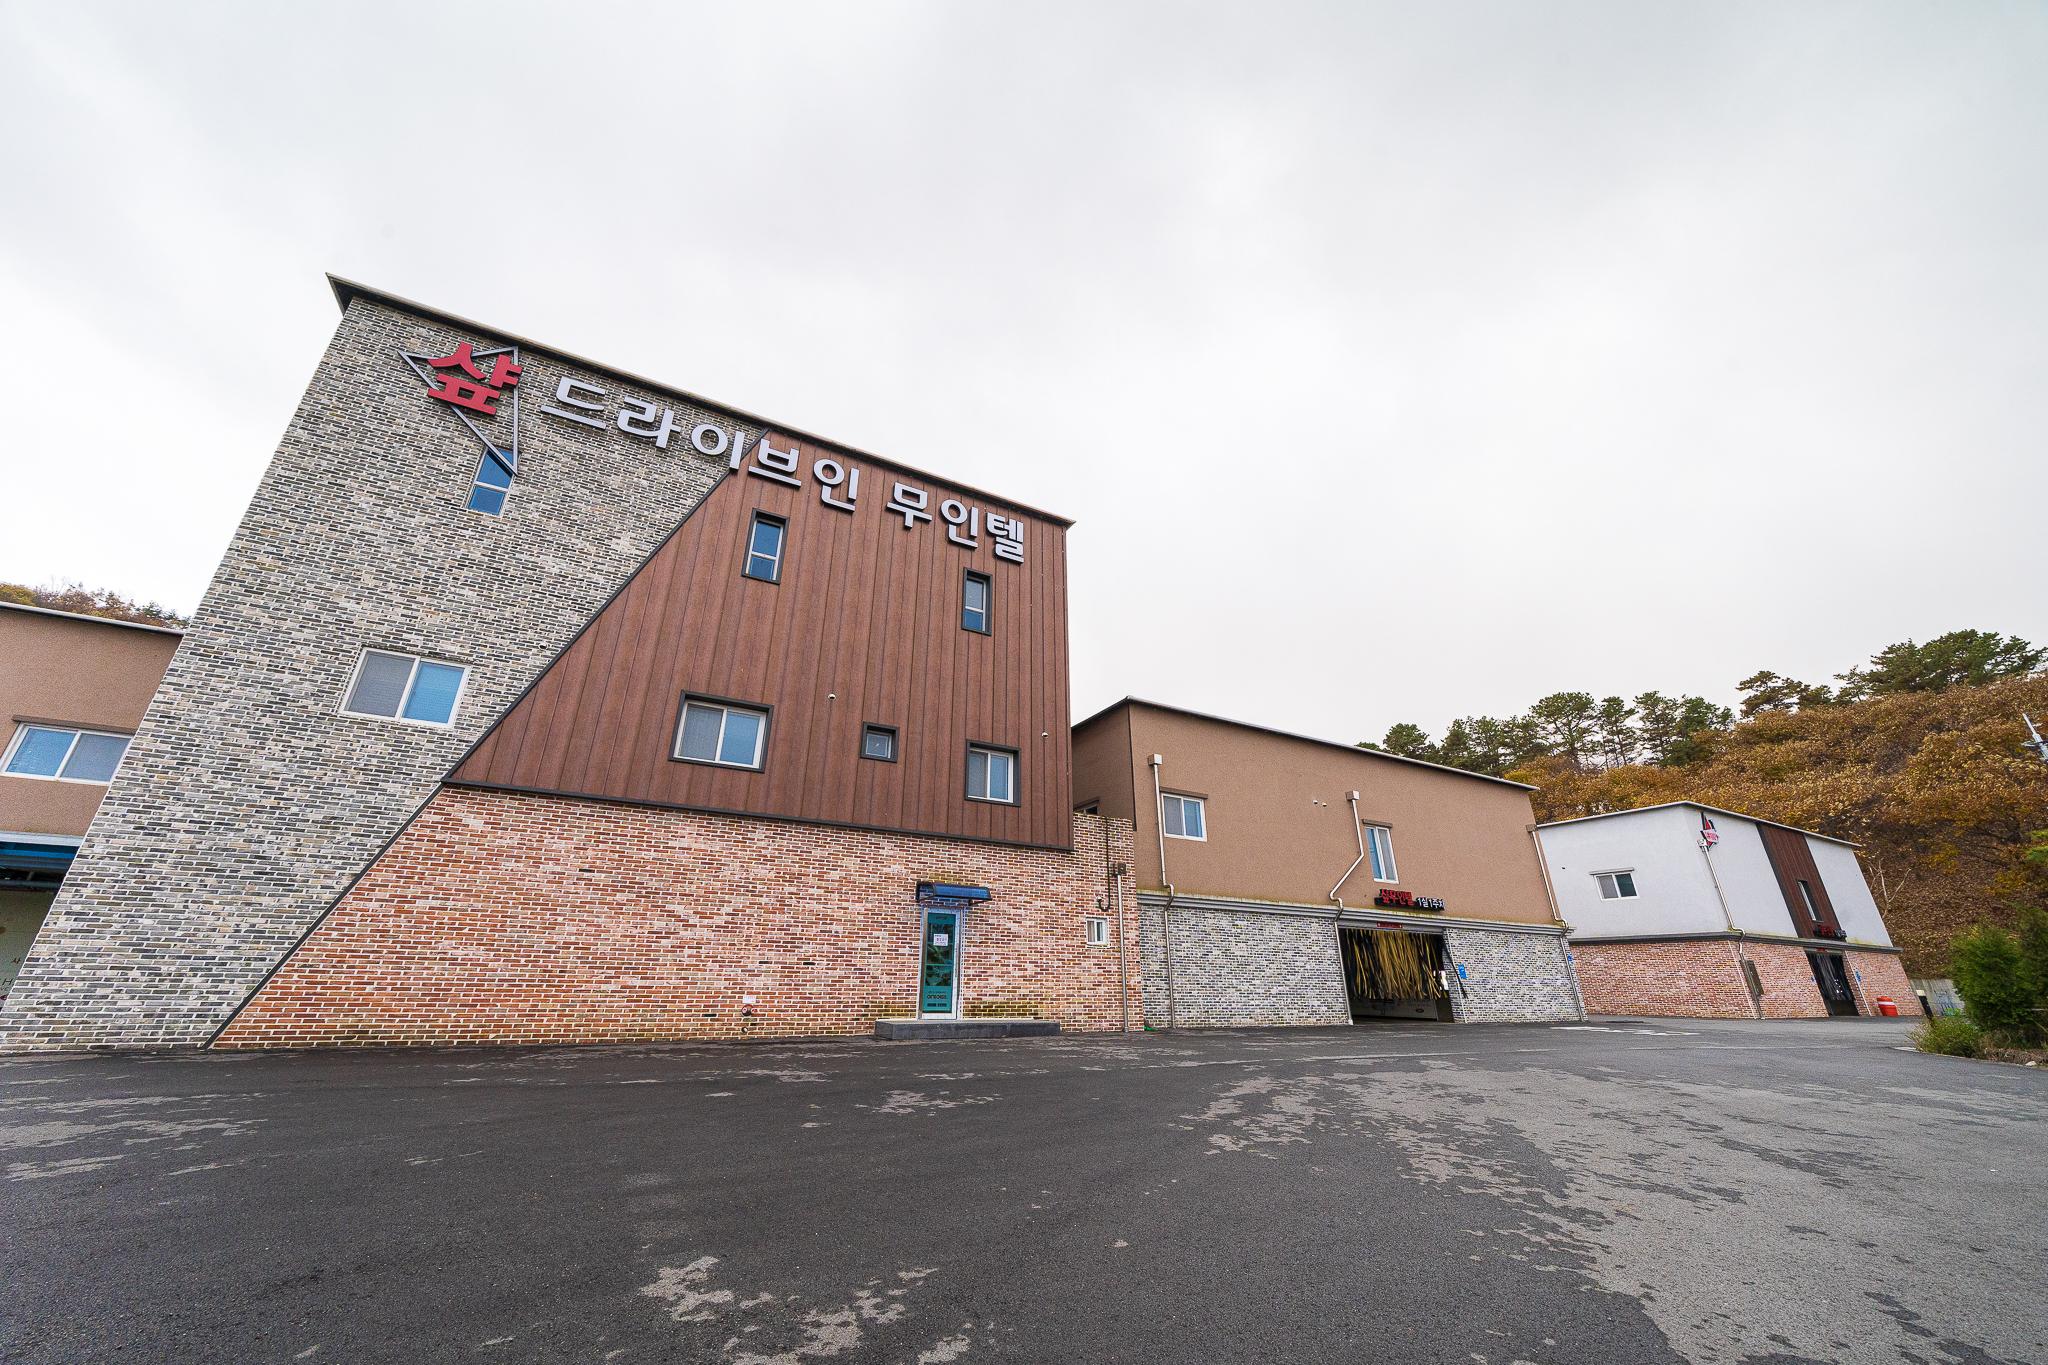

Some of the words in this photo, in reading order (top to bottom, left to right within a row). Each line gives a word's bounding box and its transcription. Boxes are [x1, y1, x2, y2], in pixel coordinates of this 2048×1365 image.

[427, 341, 522, 415] 샾
[541, 375, 860, 512] 드라이브인
[887, 482, 1024, 563] 무인텔
